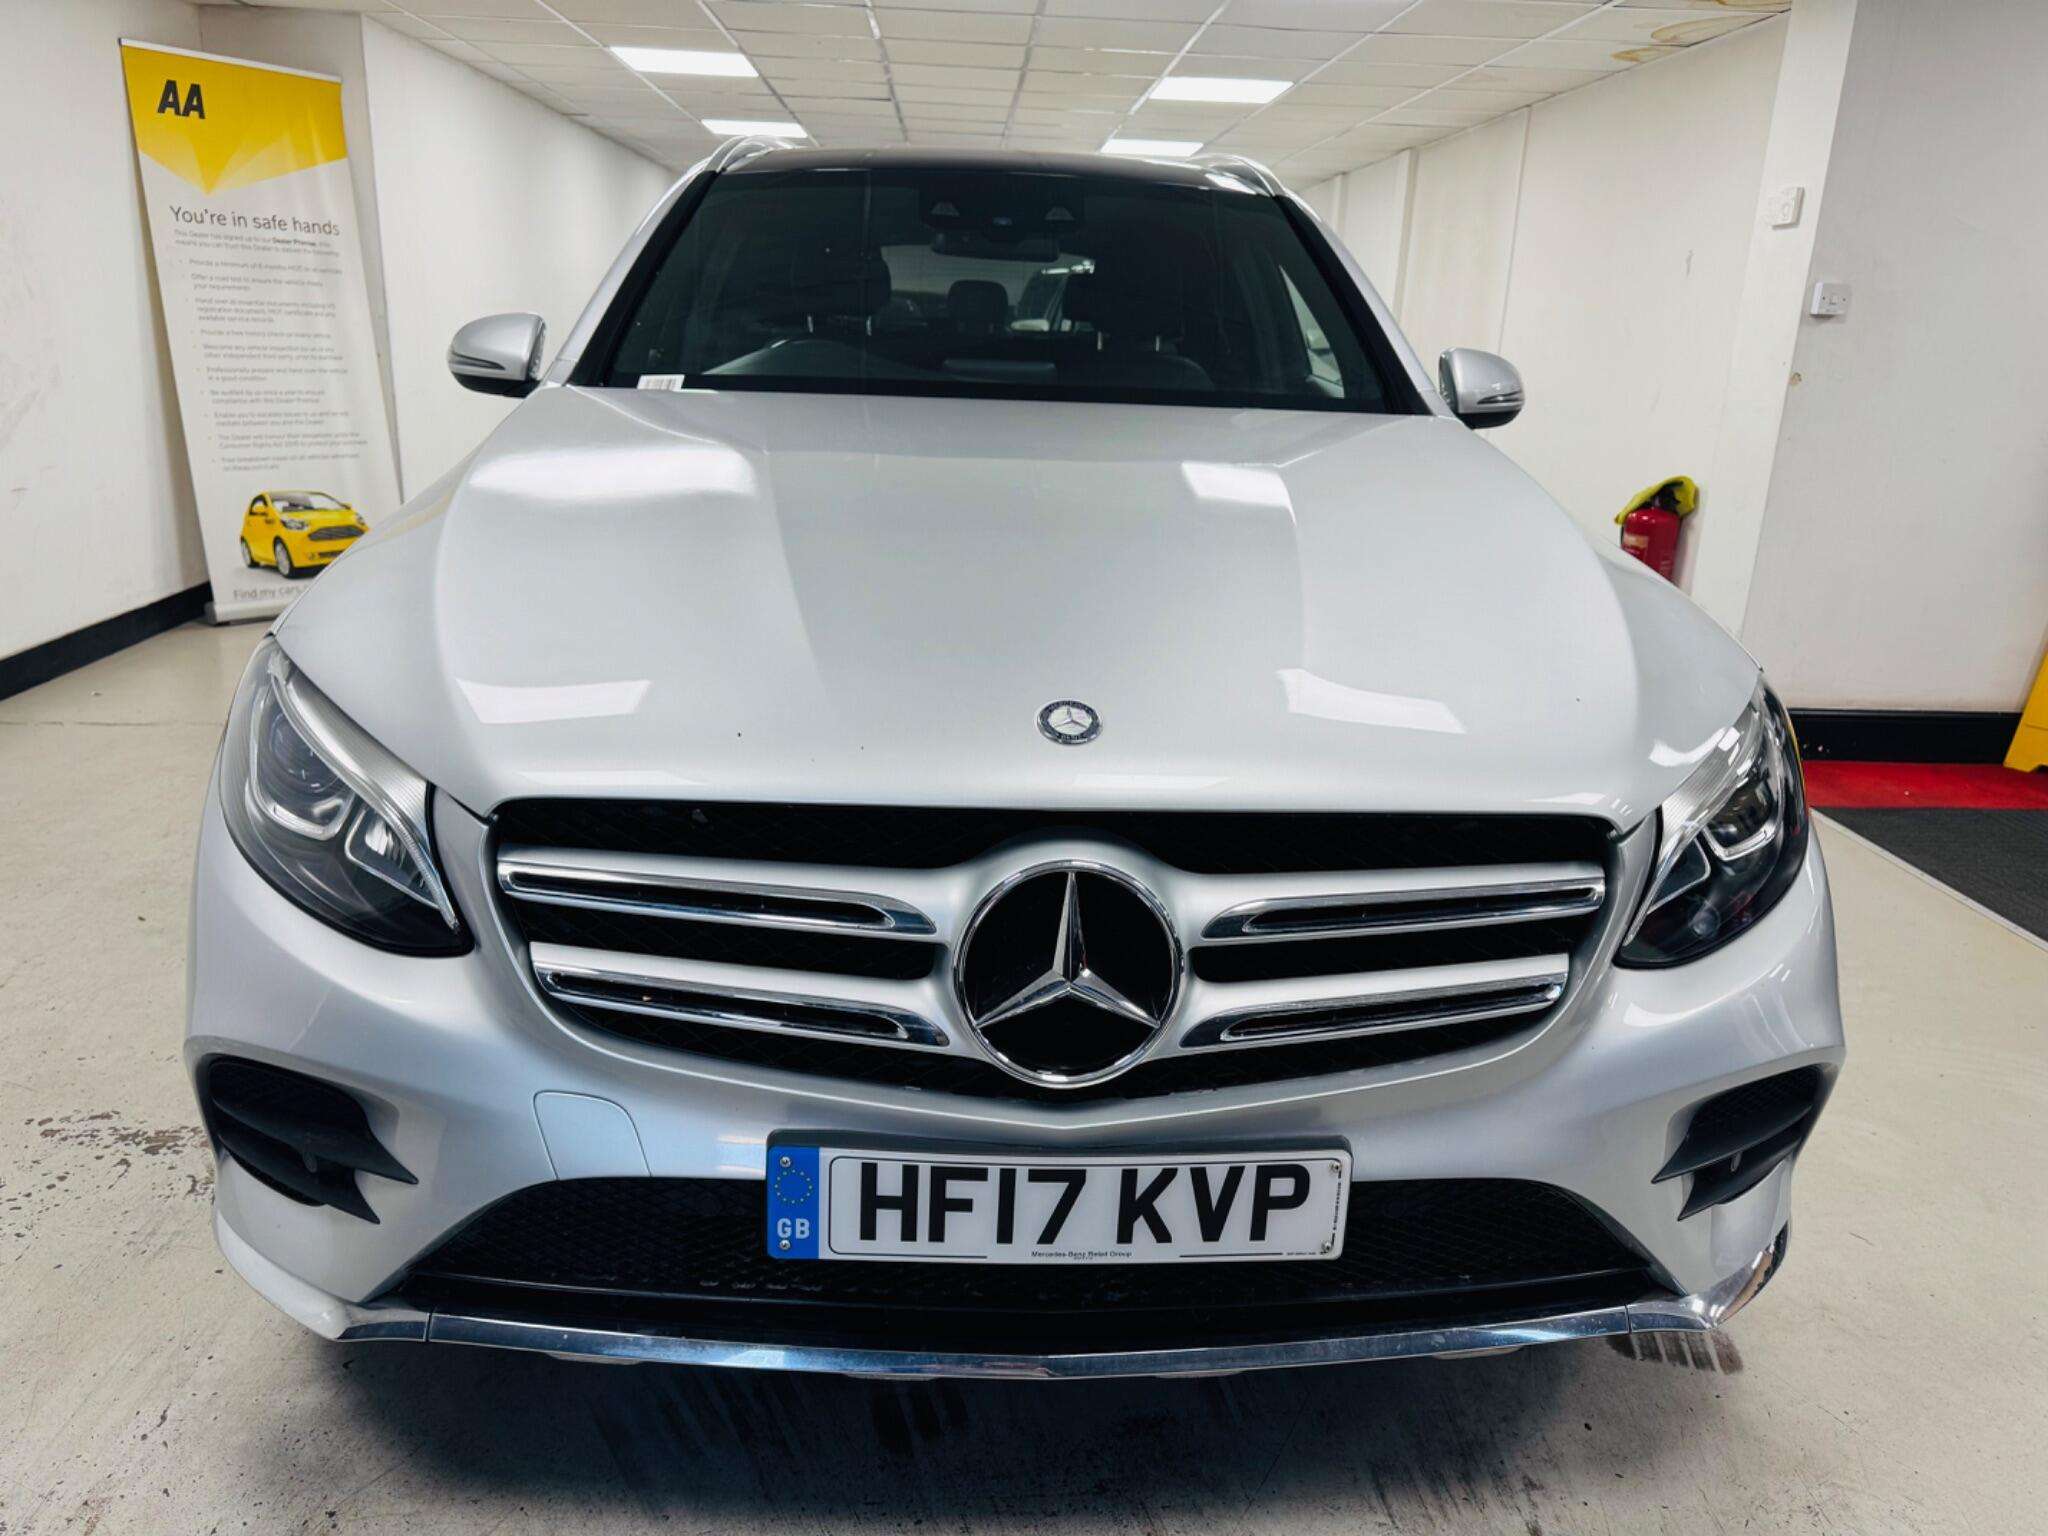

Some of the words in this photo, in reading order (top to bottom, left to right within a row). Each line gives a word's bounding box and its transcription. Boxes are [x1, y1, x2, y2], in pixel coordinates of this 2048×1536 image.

[157, 79, 206, 120] AA
[170, 205, 227, 226] You're
[231, 212, 248, 228] in
[253, 214, 288, 231] safe
[292, 217, 340, 236] hands
[233, 589, 257, 599] Find
[259, 588, 276, 598] my
[859, 1162, 1087, 1245] HF17
[1116, 1163, 1312, 1246] KVP
[777, 1217, 810, 1240] GB
[1109, 1250, 1133, 1259] Group
